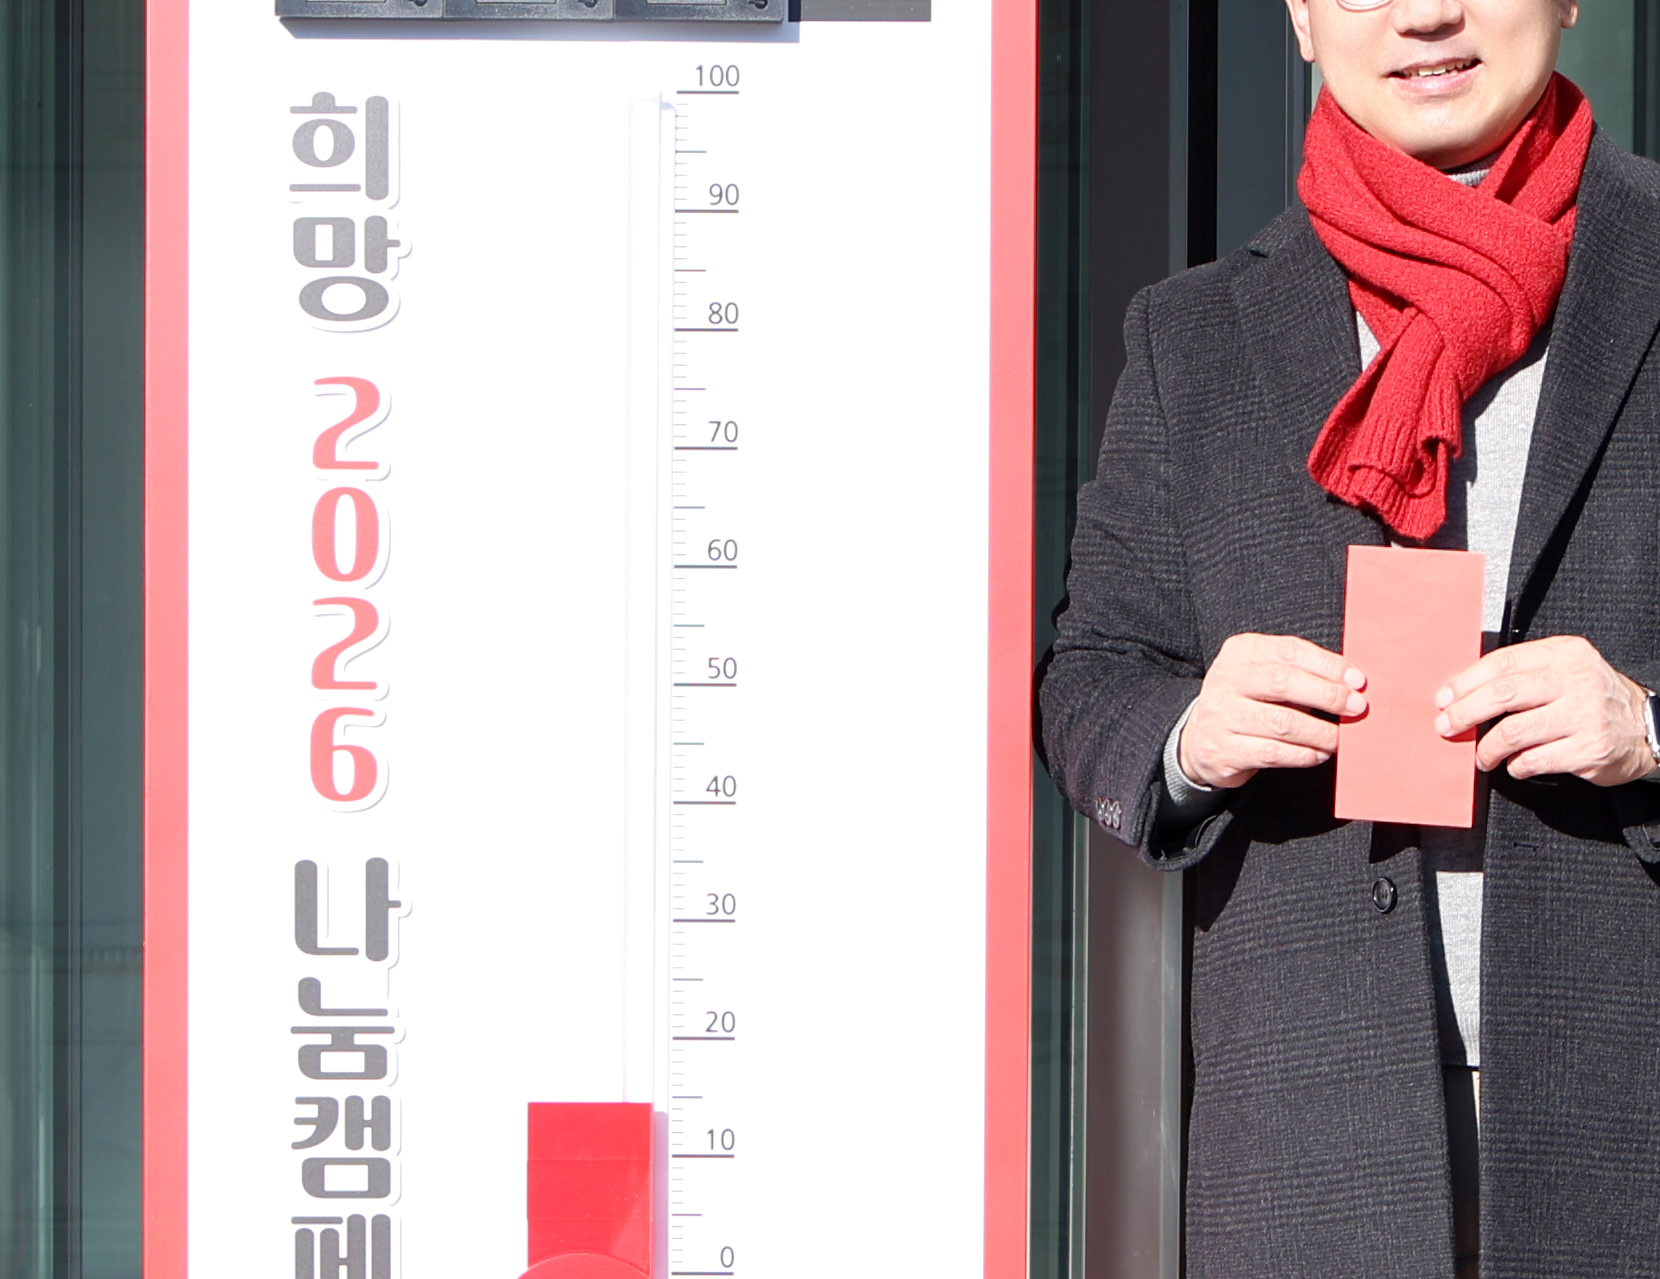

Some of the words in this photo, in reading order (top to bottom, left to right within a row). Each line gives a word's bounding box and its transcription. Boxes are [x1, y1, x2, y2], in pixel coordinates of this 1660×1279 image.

[696, 65, 740, 88] 100
[708, 184, 740, 206] 90
[289, 92, 401, 323] 희망
[708, 302, 739, 325] 80
[708, 421, 738, 443] 70
[707, 539, 738, 562] 60
[310, 376, 380, 802] 2026
[708, 657, 738, 680] 50
[706, 775, 737, 798] 40
[706, 893, 737, 916] 30
[706, 1011, 736, 1034] 20
[707, 1129, 736, 1151] 10
[719, 1246, 735, 1269] 0
